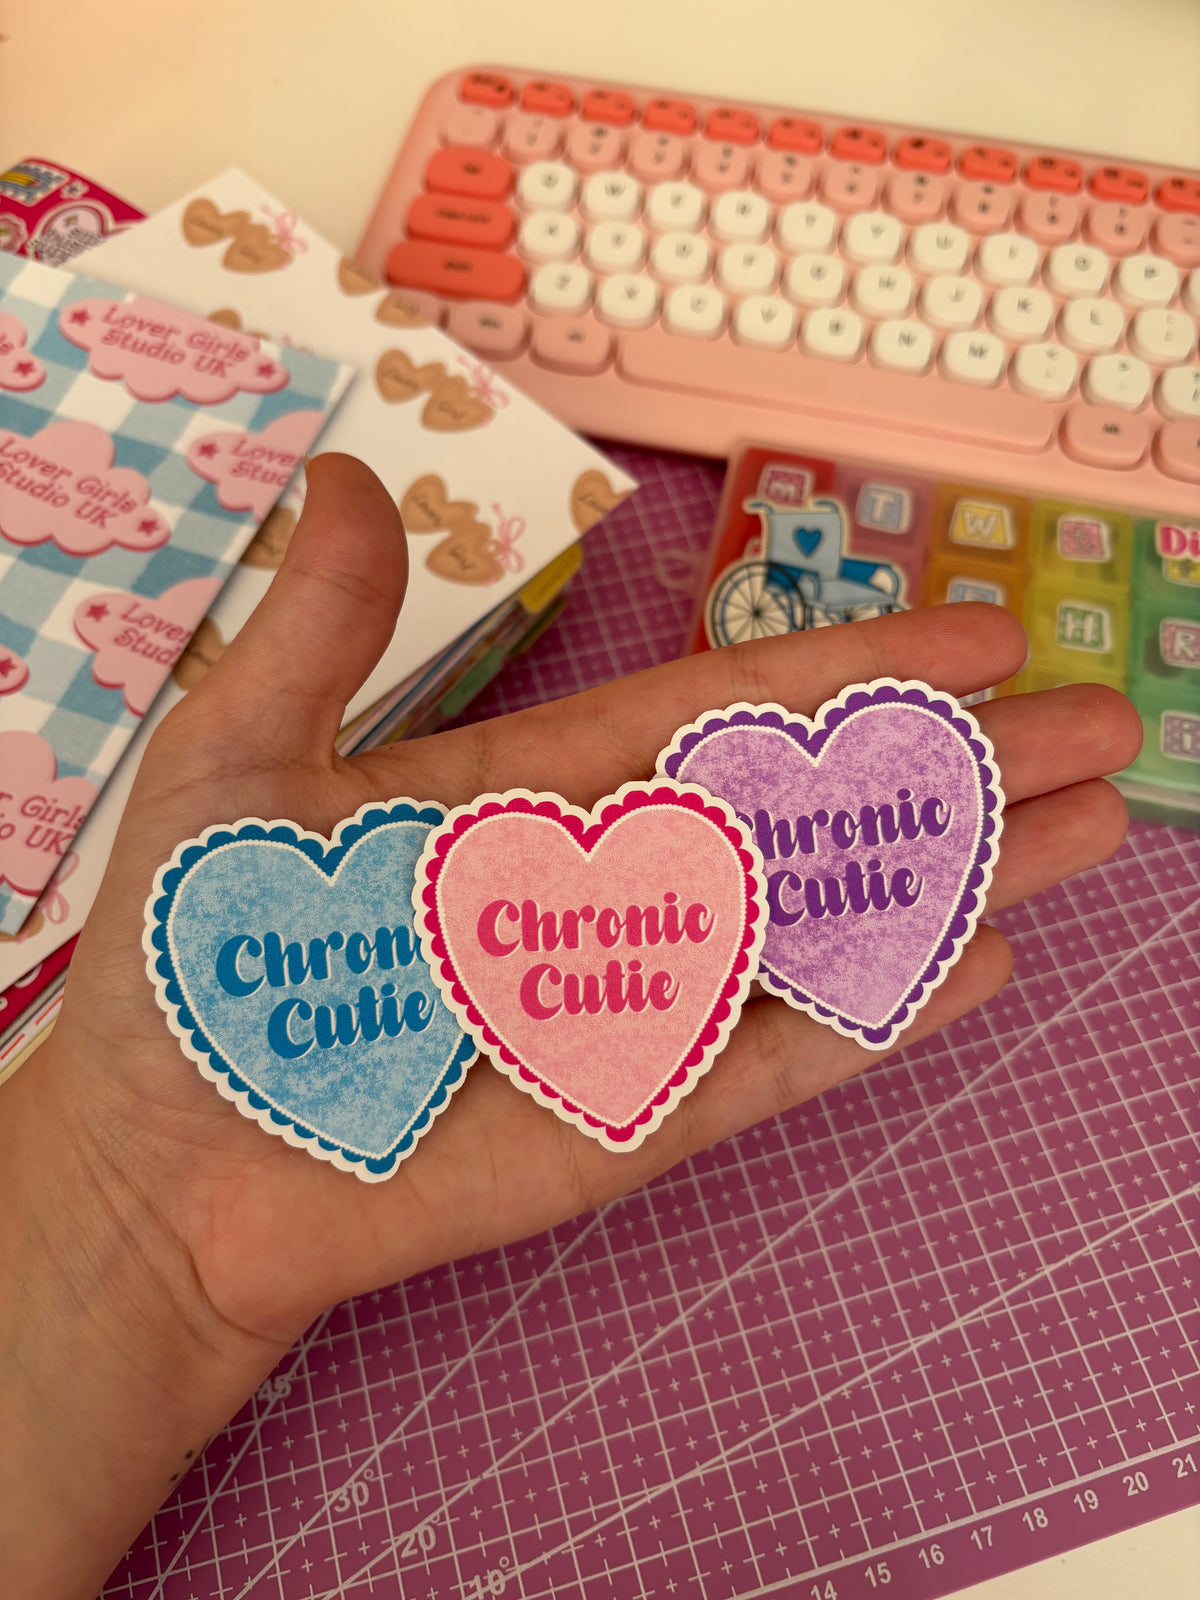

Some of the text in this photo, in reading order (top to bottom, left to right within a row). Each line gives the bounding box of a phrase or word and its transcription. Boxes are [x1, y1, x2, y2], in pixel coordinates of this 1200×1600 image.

[102, 306, 250, 362] Lover Girls
[102, 328, 235, 379] Studio UK
[75, 474, 138, 514] Girls
[74, 500, 119, 529] UK
[963, 510, 998, 538] W
[1064, 611, 1095, 644] H
[766, 859, 923, 927] Cutie
[476, 891, 715, 958] Chronic
[520, 959, 680, 1021] Cutie
[267, 982, 437, 1060] Cutie
[1170, 1453, 1198, 1479] 21
[1122, 1471, 1149, 1497] 20
[1073, 1490, 1099, 1513] 19
[1021, 1507, 1049, 1532] 18
[970, 1525, 994, 1551] 17
[918, 1544, 945, 1569] 16
[864, 1562, 892, 1588] 15
